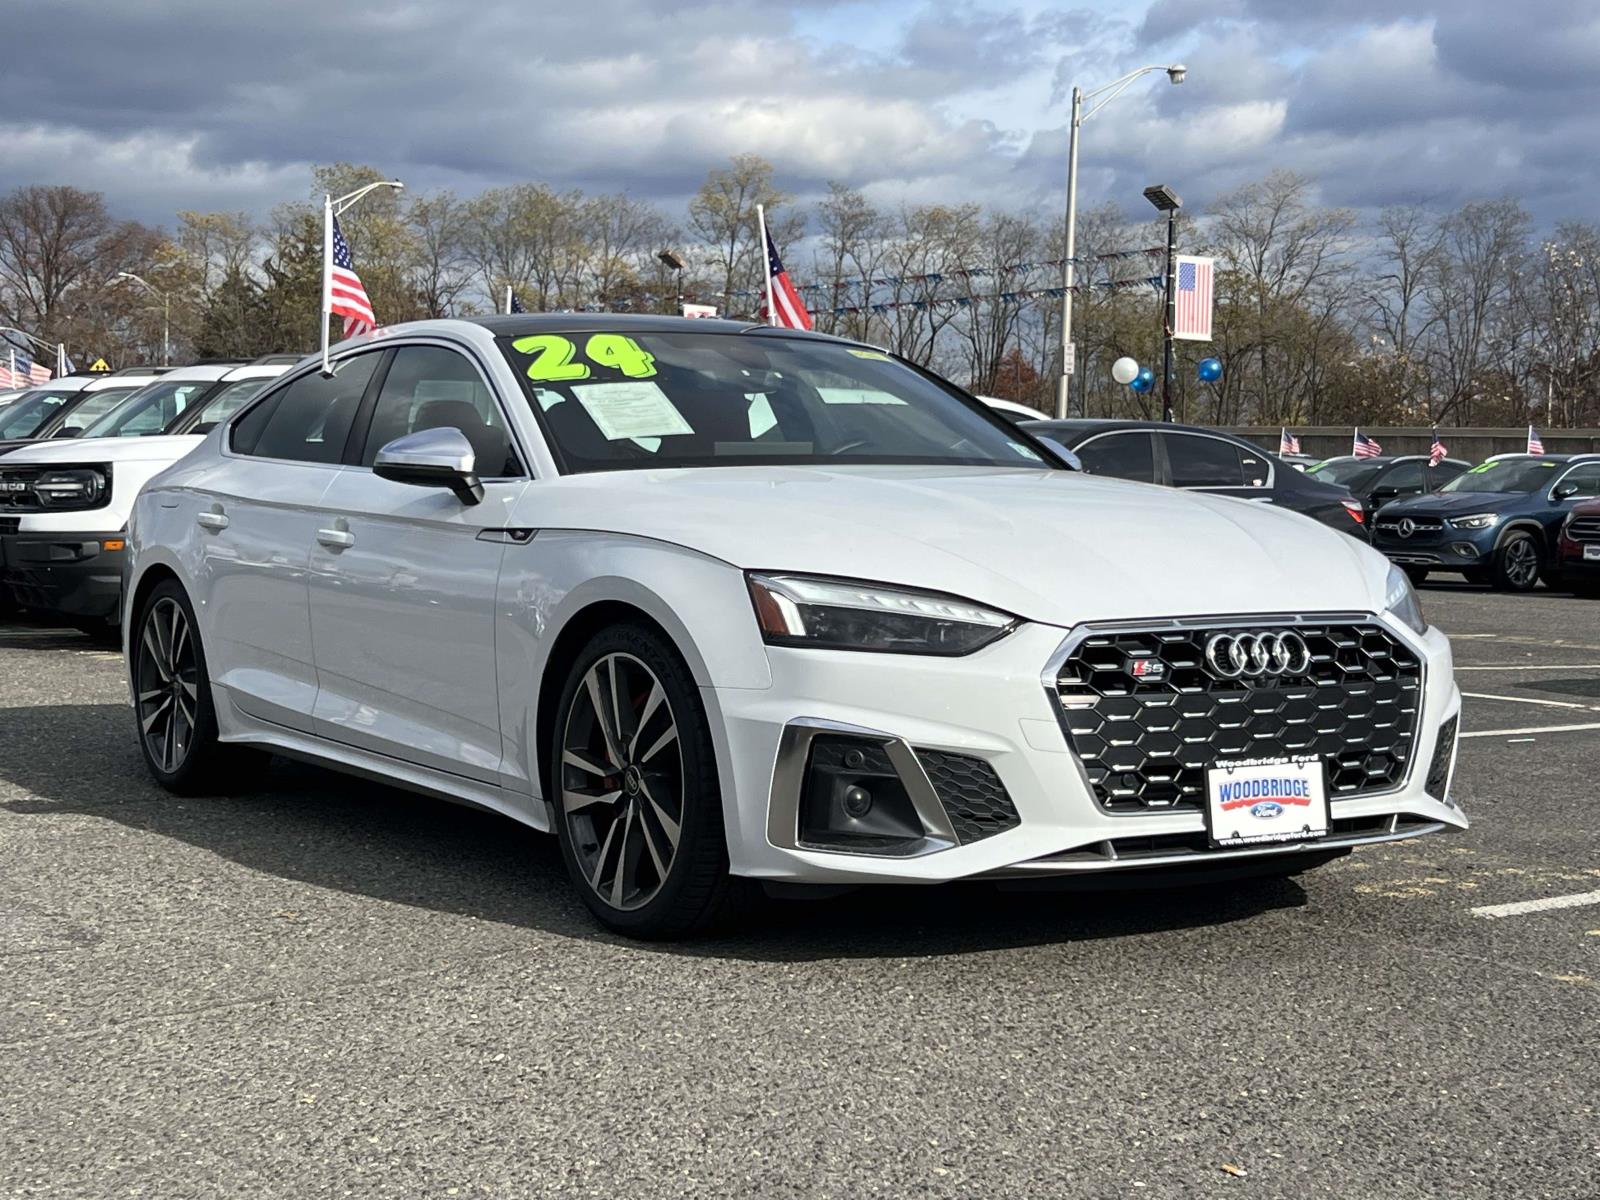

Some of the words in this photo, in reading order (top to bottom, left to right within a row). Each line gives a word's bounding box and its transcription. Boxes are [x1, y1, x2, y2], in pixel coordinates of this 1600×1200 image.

[512, 333, 657, 381] 24
[1215, 757, 1289, 768] Woodbridge
[1291, 754, 1319, 763] Ford
[1219, 778, 1310, 802] WOODBRIDGE
[1254, 804, 1280, 818] Ford
[1219, 830, 1327, 846] www.woodbridgeford.com
